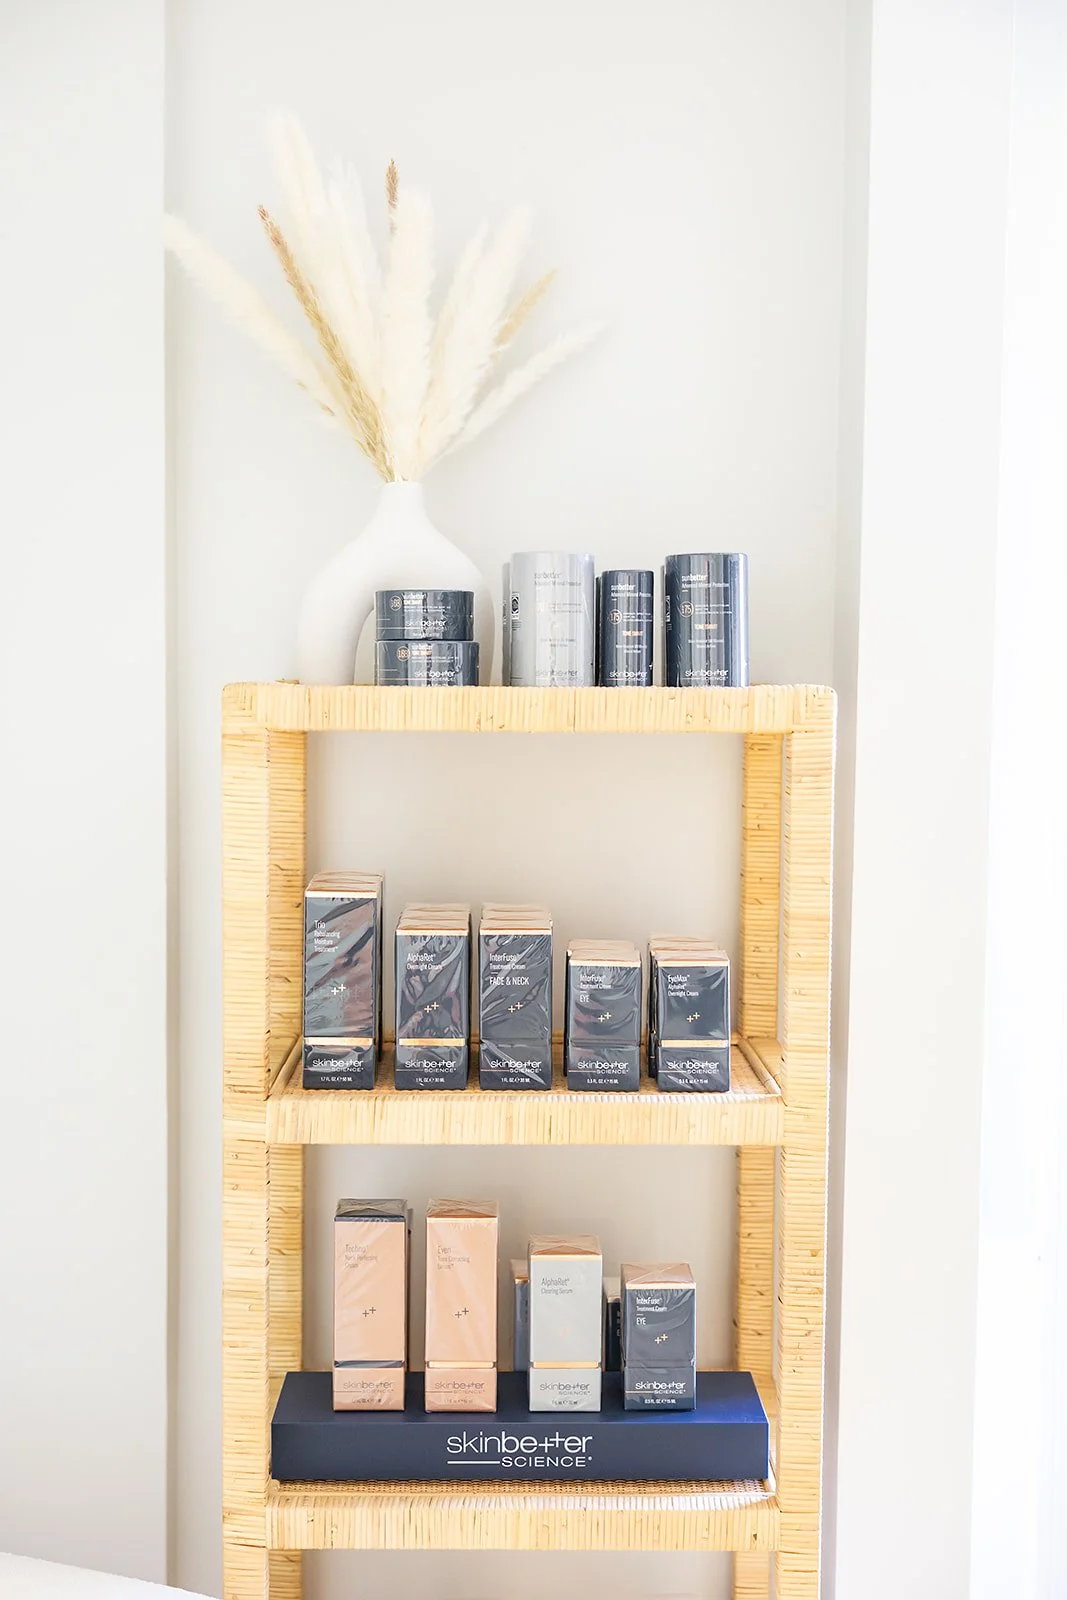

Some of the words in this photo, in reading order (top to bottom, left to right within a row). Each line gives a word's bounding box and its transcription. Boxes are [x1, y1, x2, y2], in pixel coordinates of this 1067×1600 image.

[314, 920, 326, 929] Trio
[489, 976, 505, 986] FACE
[506, 976, 511, 986] &
[512, 976, 530, 986] NECK
[580, 994, 590, 1003] EYE
[312, 1058, 364, 1067] skinbetter
[405, 1059, 456, 1068] skinbetter
[490, 1059, 542, 1068] skinbetter
[577, 1060, 629, 1069] skinbetter
[667, 1060, 719, 1069] skinbetter
[636, 1317, 646, 1325] EYE
[343, 1381, 394, 1389] skinbetter
[434, 1381, 485, 1390] skinbetter
[539, 1382, 590, 1391] skinbetter
[635, 1381, 686, 1390] skinbetter
[446, 1430, 593, 1454] skinbetter
